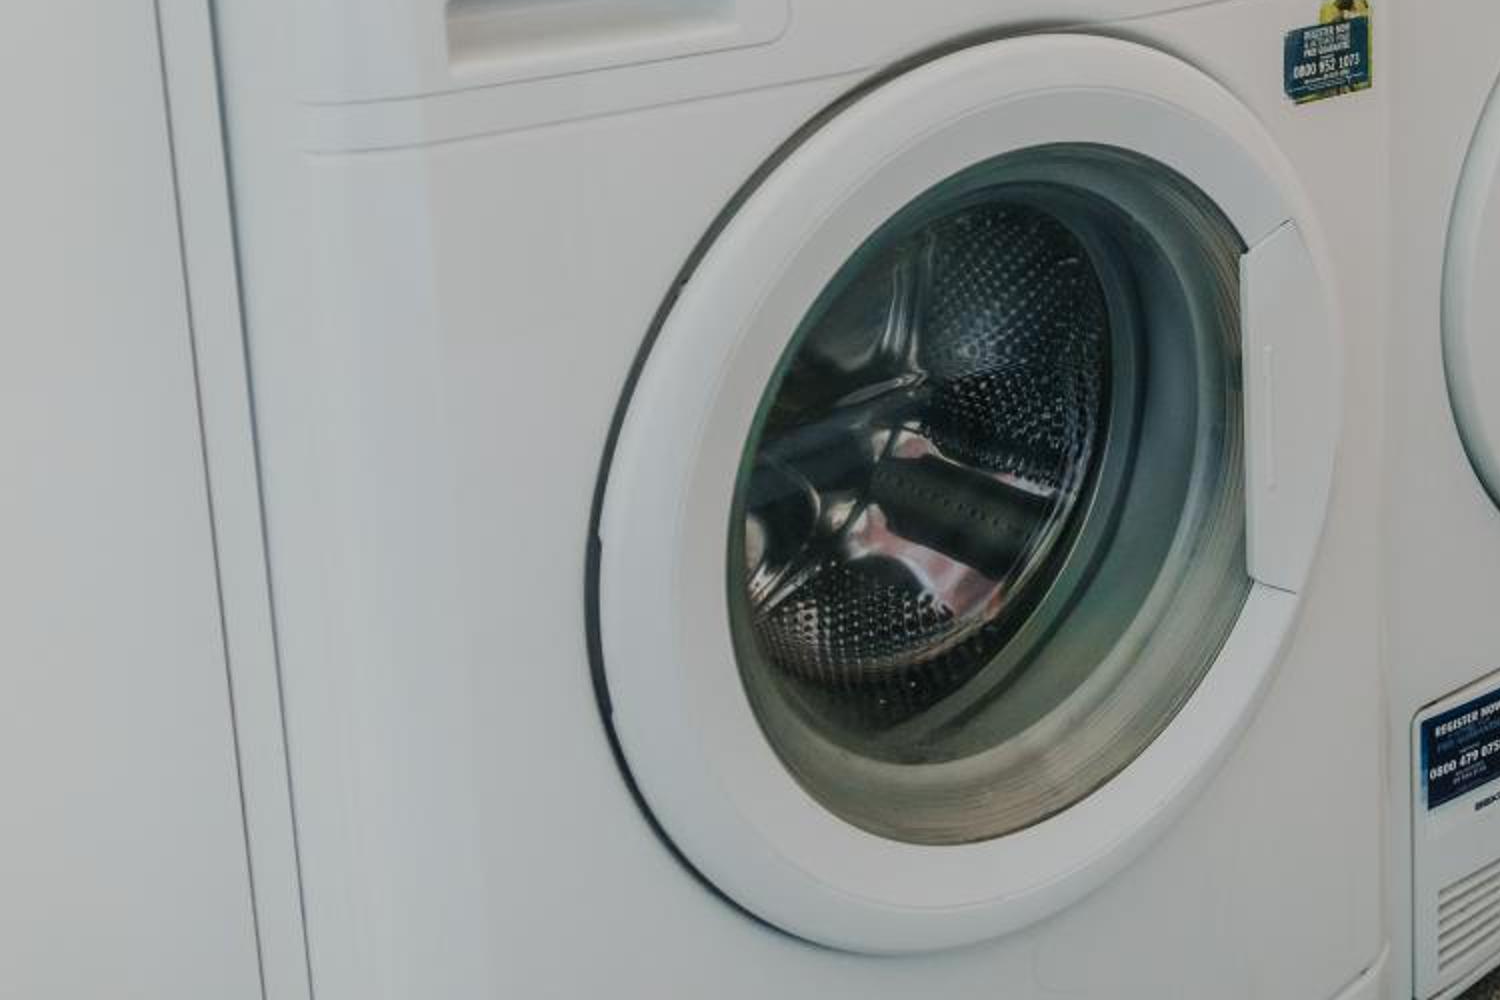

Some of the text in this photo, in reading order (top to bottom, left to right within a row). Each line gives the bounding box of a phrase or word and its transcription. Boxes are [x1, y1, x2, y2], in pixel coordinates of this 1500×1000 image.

[1435, 710, 1479, 737] REGISTER
[1429, 760, 1457, 780] 0800
[1459, 749, 1480, 767] 479
